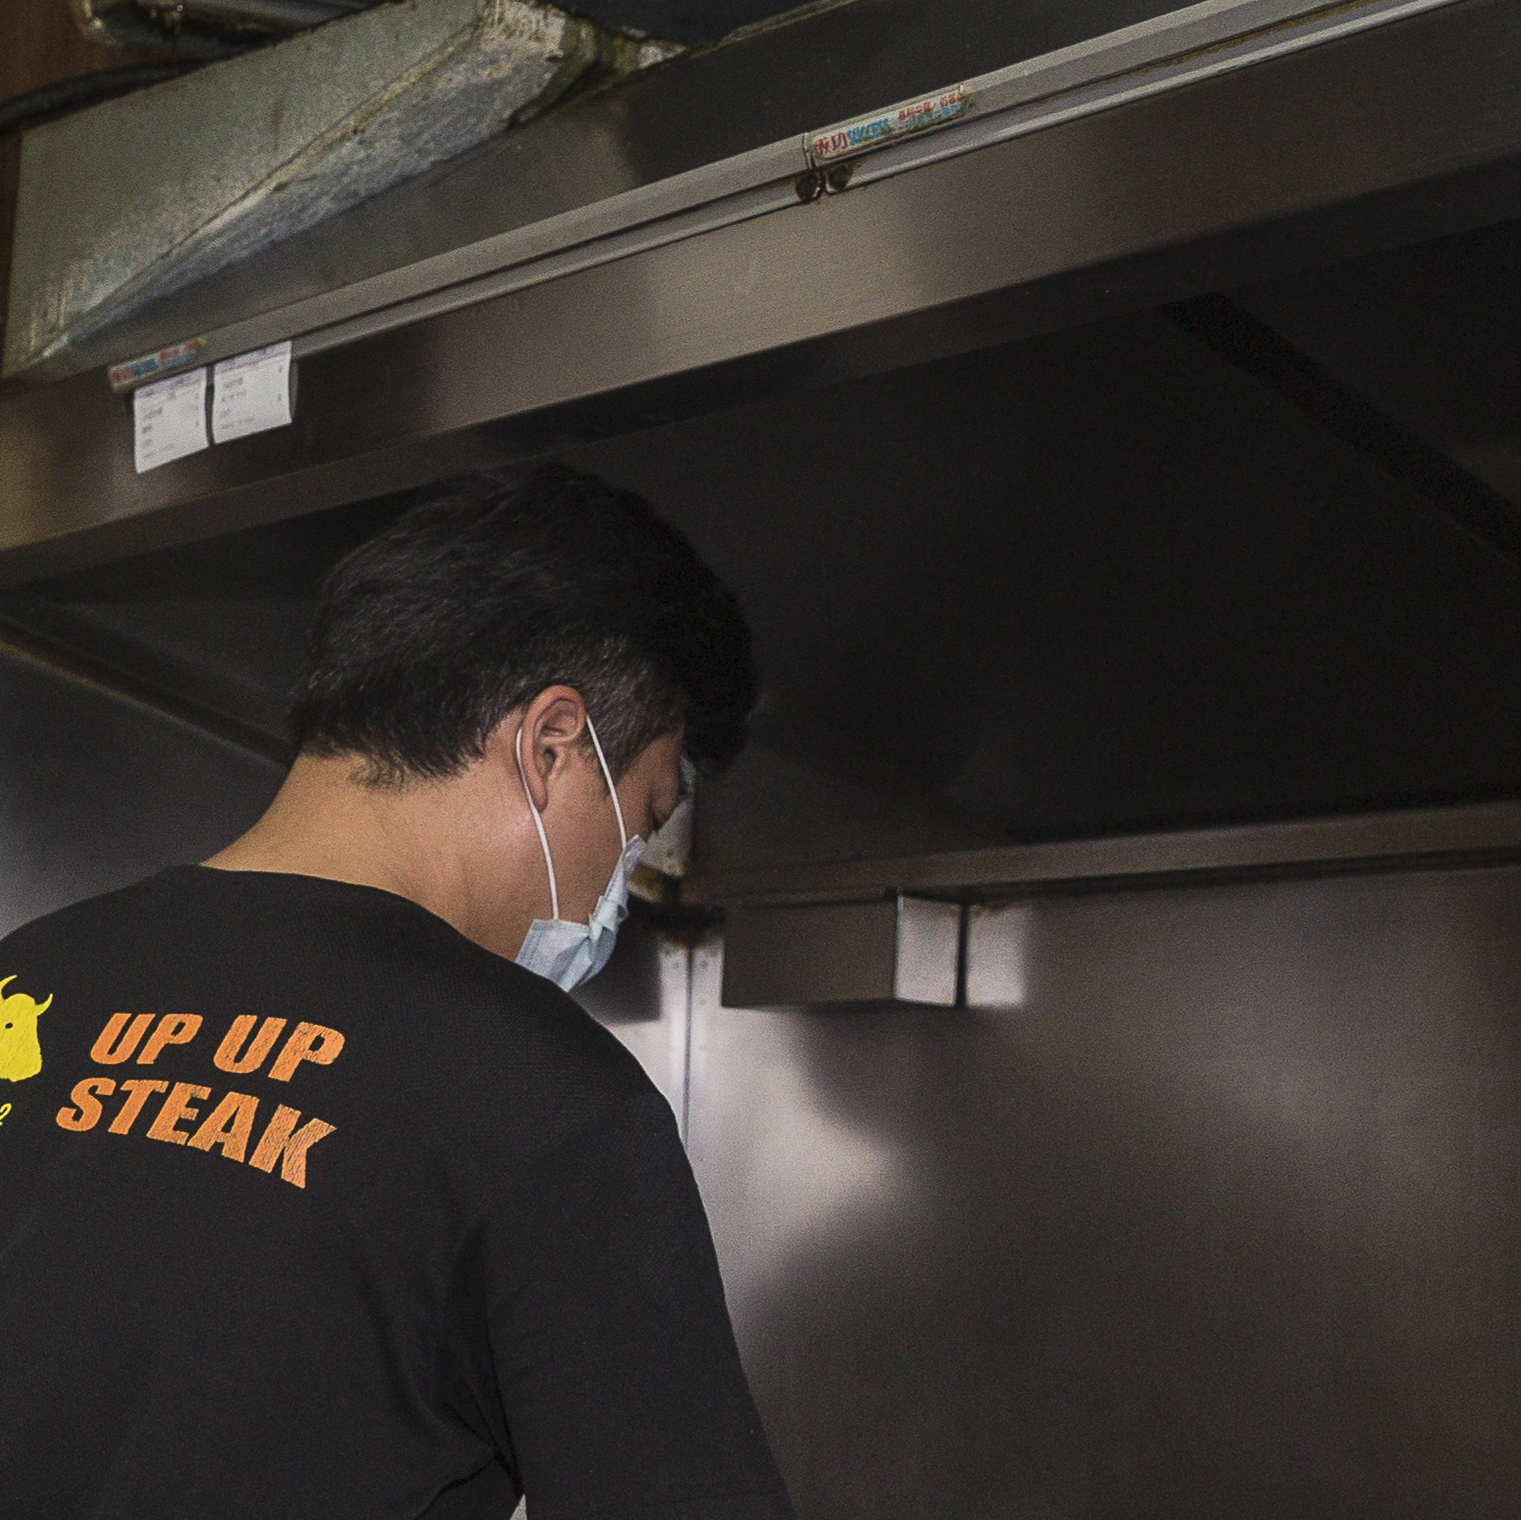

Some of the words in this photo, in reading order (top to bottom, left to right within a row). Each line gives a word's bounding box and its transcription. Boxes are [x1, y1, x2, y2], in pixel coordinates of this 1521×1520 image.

[90, 1013, 203, 1065] UP
[213, 1014, 345, 1082] UP
[55, 1077, 336, 1189] STEAK
